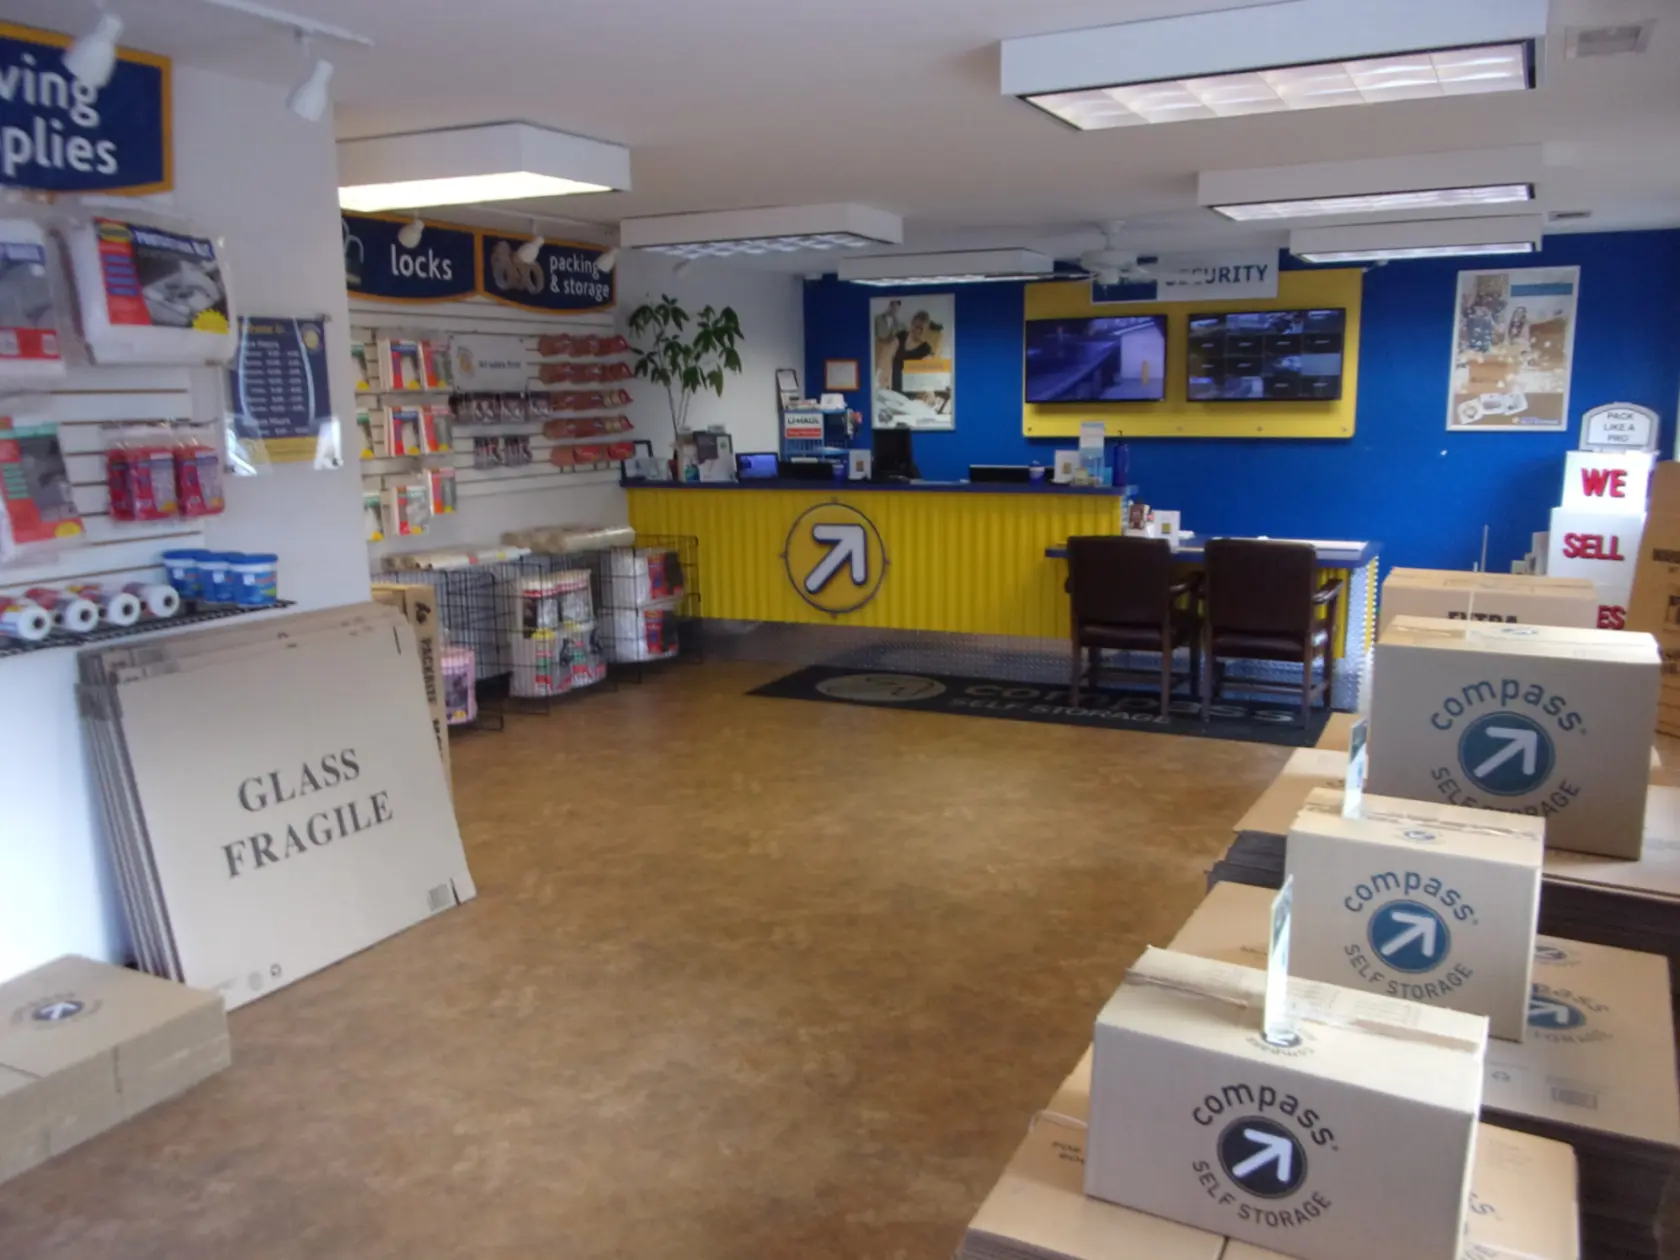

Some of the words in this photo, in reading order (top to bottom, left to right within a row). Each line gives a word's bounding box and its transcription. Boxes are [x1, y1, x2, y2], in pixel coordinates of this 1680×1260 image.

[390, 244, 452, 280] locks
[550, 253, 600, 280] packing
[550, 275, 560, 293] &
[564, 278, 609, 301] storage
[1604, 423, 1625, 431] LIKE
[1627, 423, 1636, 431] A
[1607, 411, 1633, 420] PACK
[1581, 468, 1627, 498] WE
[1562, 533, 1624, 561] SELL
[1028, 705, 1172, 725] STORAGE
[1431, 678, 1582, 732] compass
[237, 748, 361, 813] GLASS
[221, 790, 394, 879] FRAGILE
[1344, 871, 1475, 922] compass
[1344, 944, 1386, 984] SELF
[1386, 962, 1474, 1001] STORAGE
[1193, 1083, 1334, 1147] compass
[1193, 1160, 1237, 1207] SELF
[1237, 1190, 1333, 1229] STORAGE
